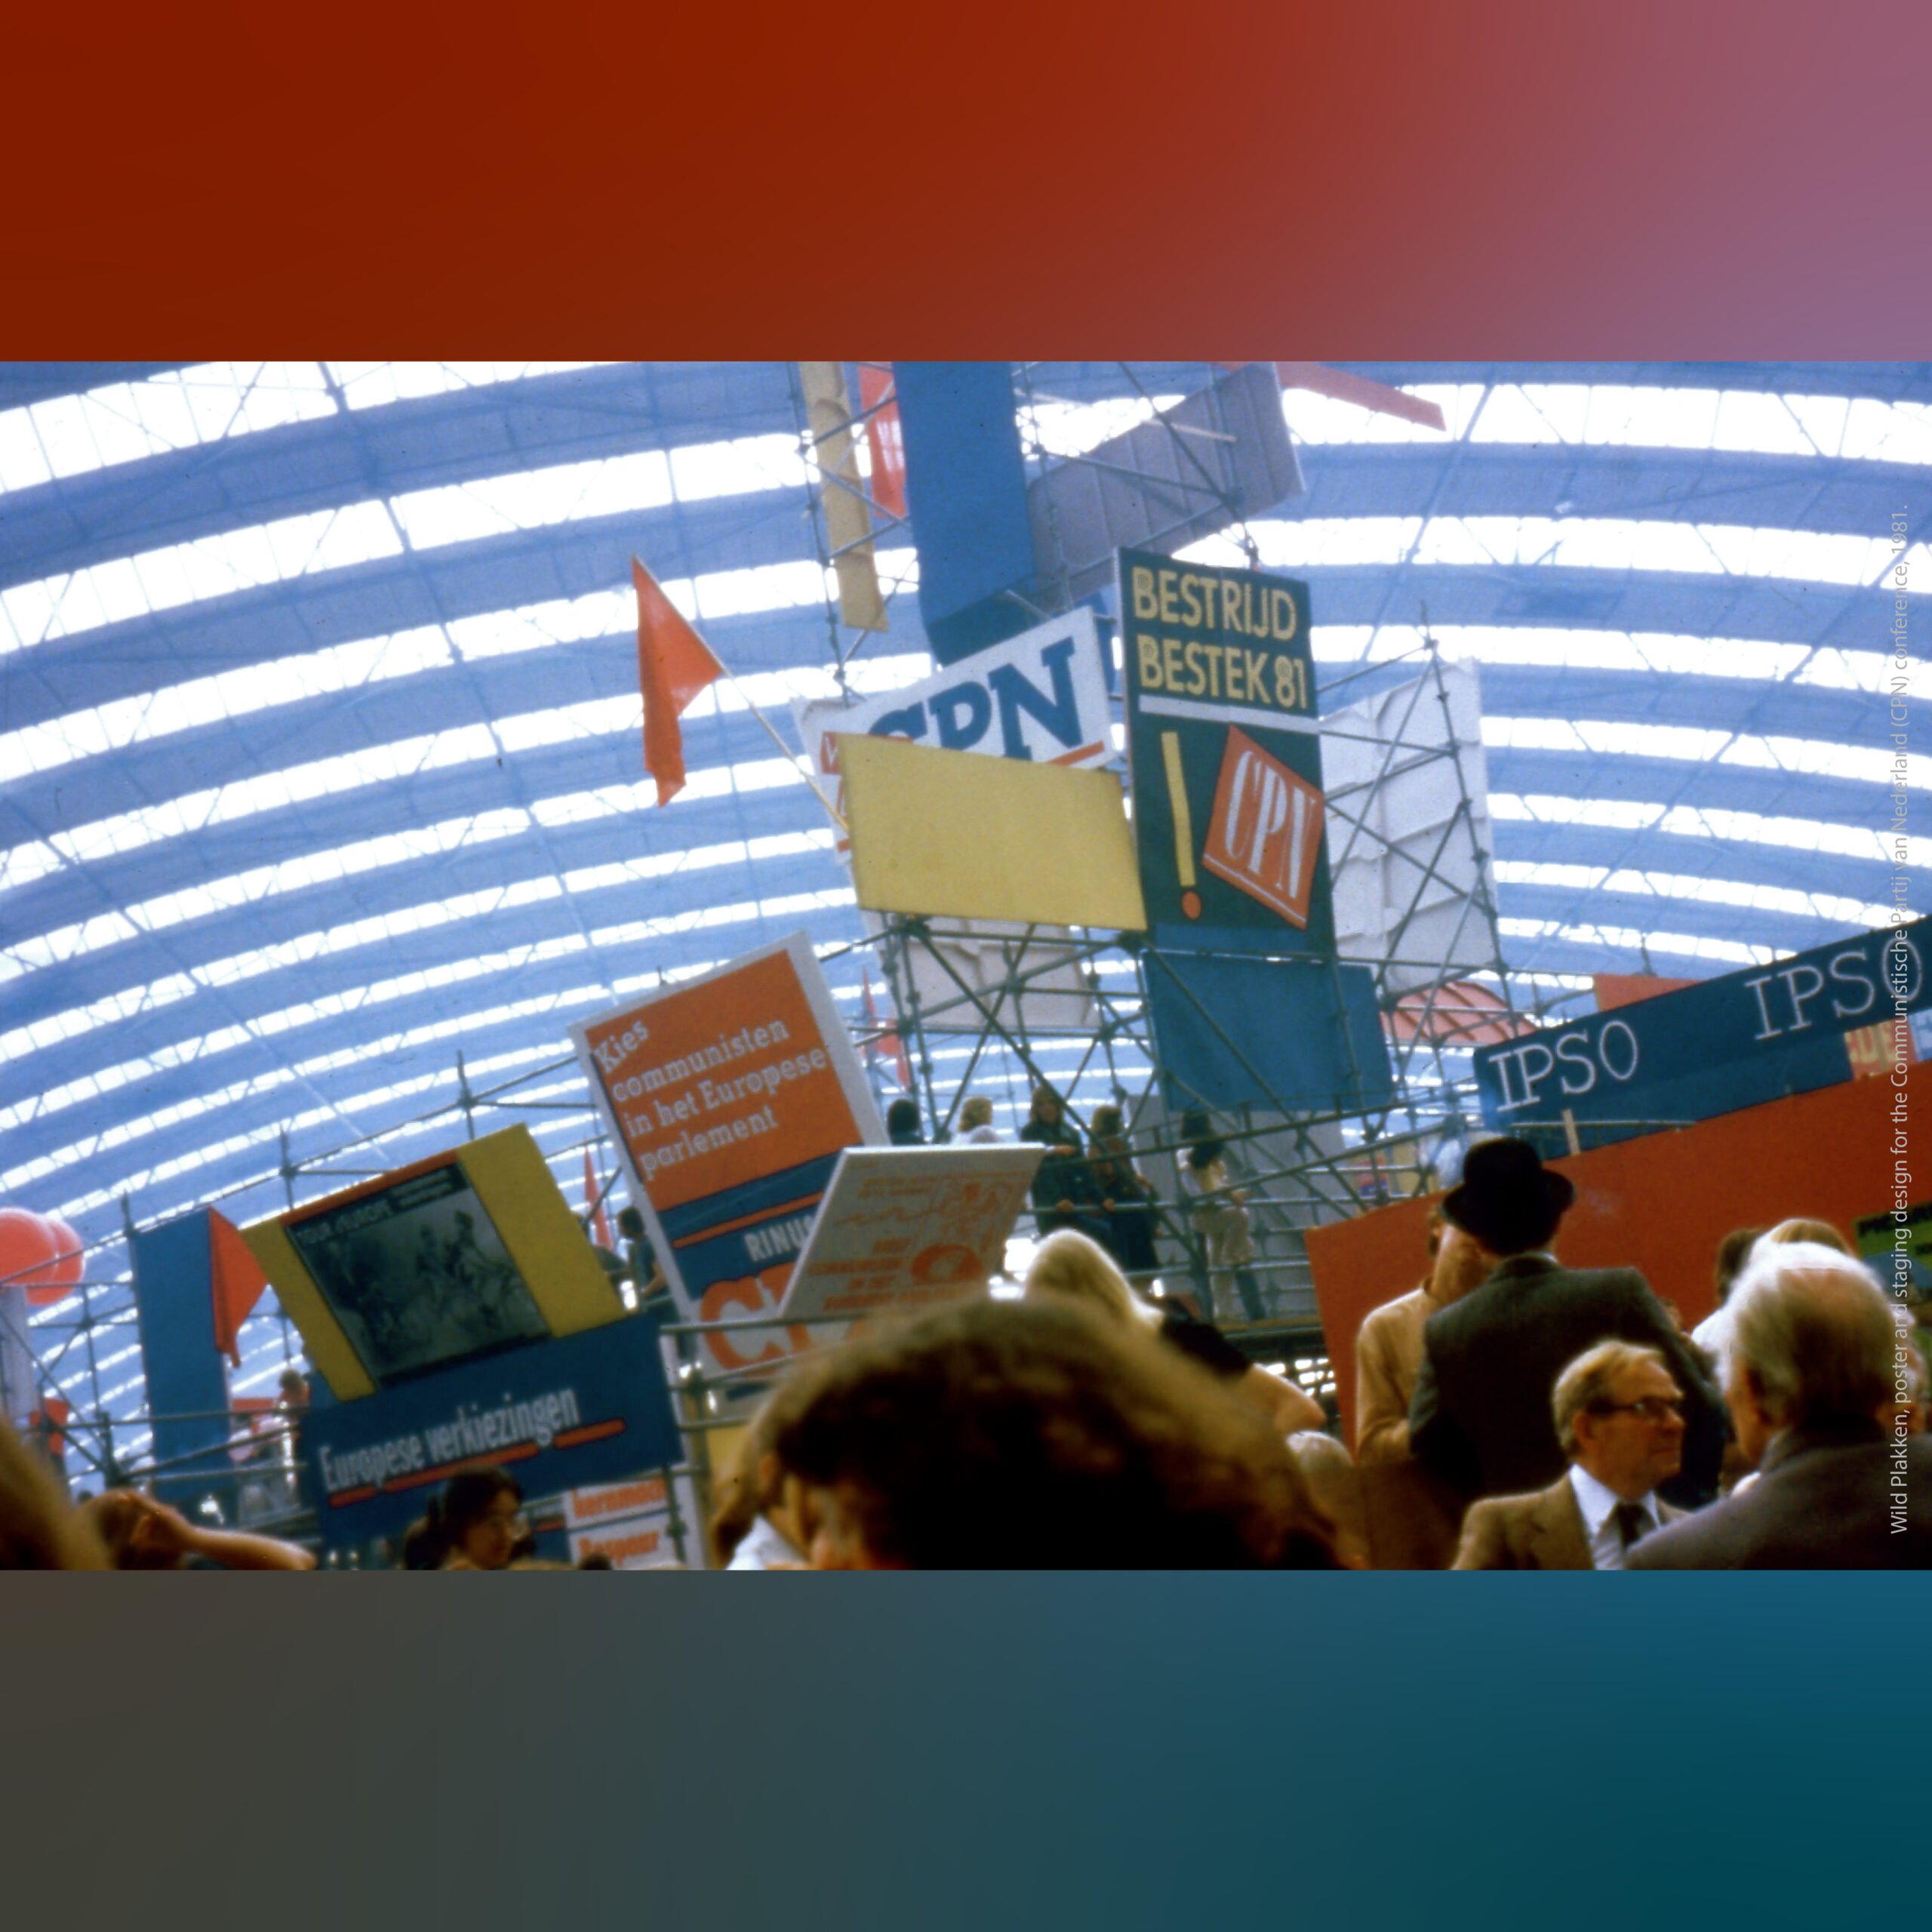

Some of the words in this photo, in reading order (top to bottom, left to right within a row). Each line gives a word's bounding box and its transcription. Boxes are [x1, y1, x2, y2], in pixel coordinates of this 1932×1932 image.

[1133, 567, 1297, 641] BESTRIJD
[1137, 635, 1271, 703] BESTEK
[1274, 655, 1307, 709] 81
[1224, 750, 1315, 900] CPN
[1745, 938, 1922, 1041] IPSO
[595, 1020, 649, 1075] Kies
[611, 1019, 789, 1102] communisten
[1488, 1020, 1638, 1112] IPSO
[623, 1112, 654, 1138] in
[653, 1091, 700, 1127] het
[697, 1047, 828, 1110] Europese
[638, 1103, 779, 1181] parlement
[318, 1435, 425, 1491] Europese
[425, 1389, 581, 1463] verkiezingen
